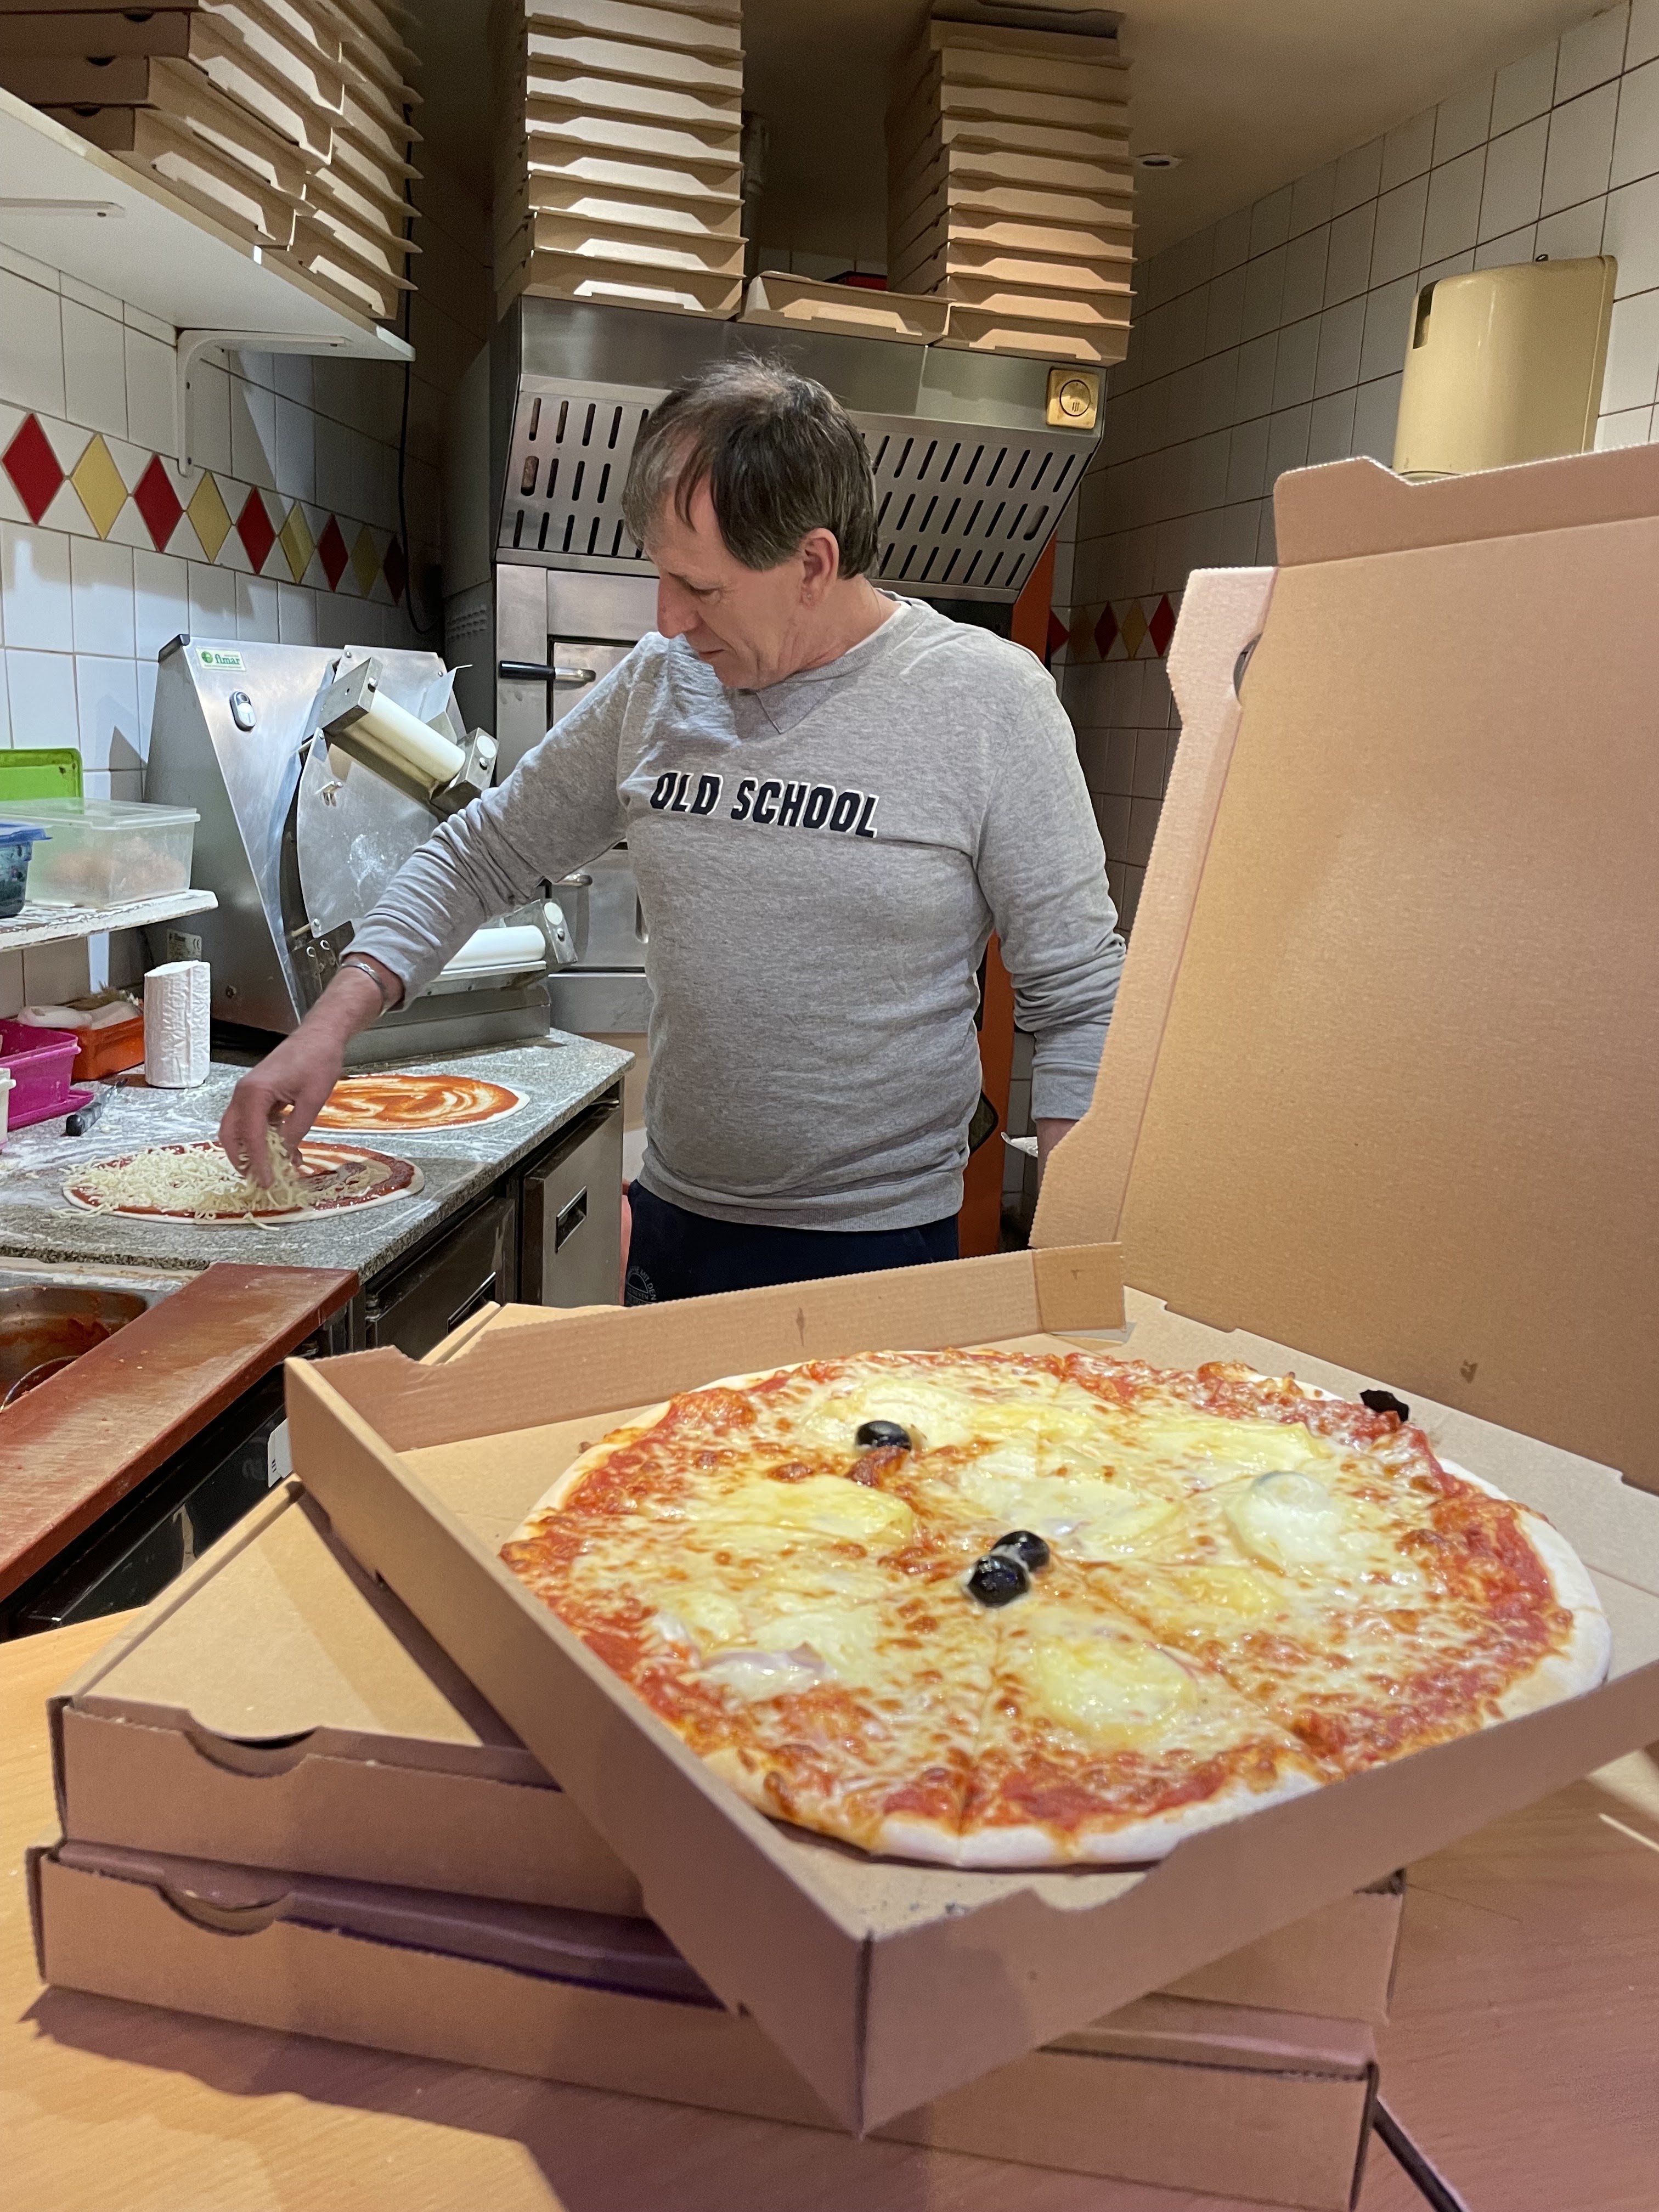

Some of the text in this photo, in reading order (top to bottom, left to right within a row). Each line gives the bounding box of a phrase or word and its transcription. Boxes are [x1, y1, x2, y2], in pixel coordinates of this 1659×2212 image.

[650, 770, 879, 838] OLD SCHOOL
[647, 1283, 657, 1300] DEN
